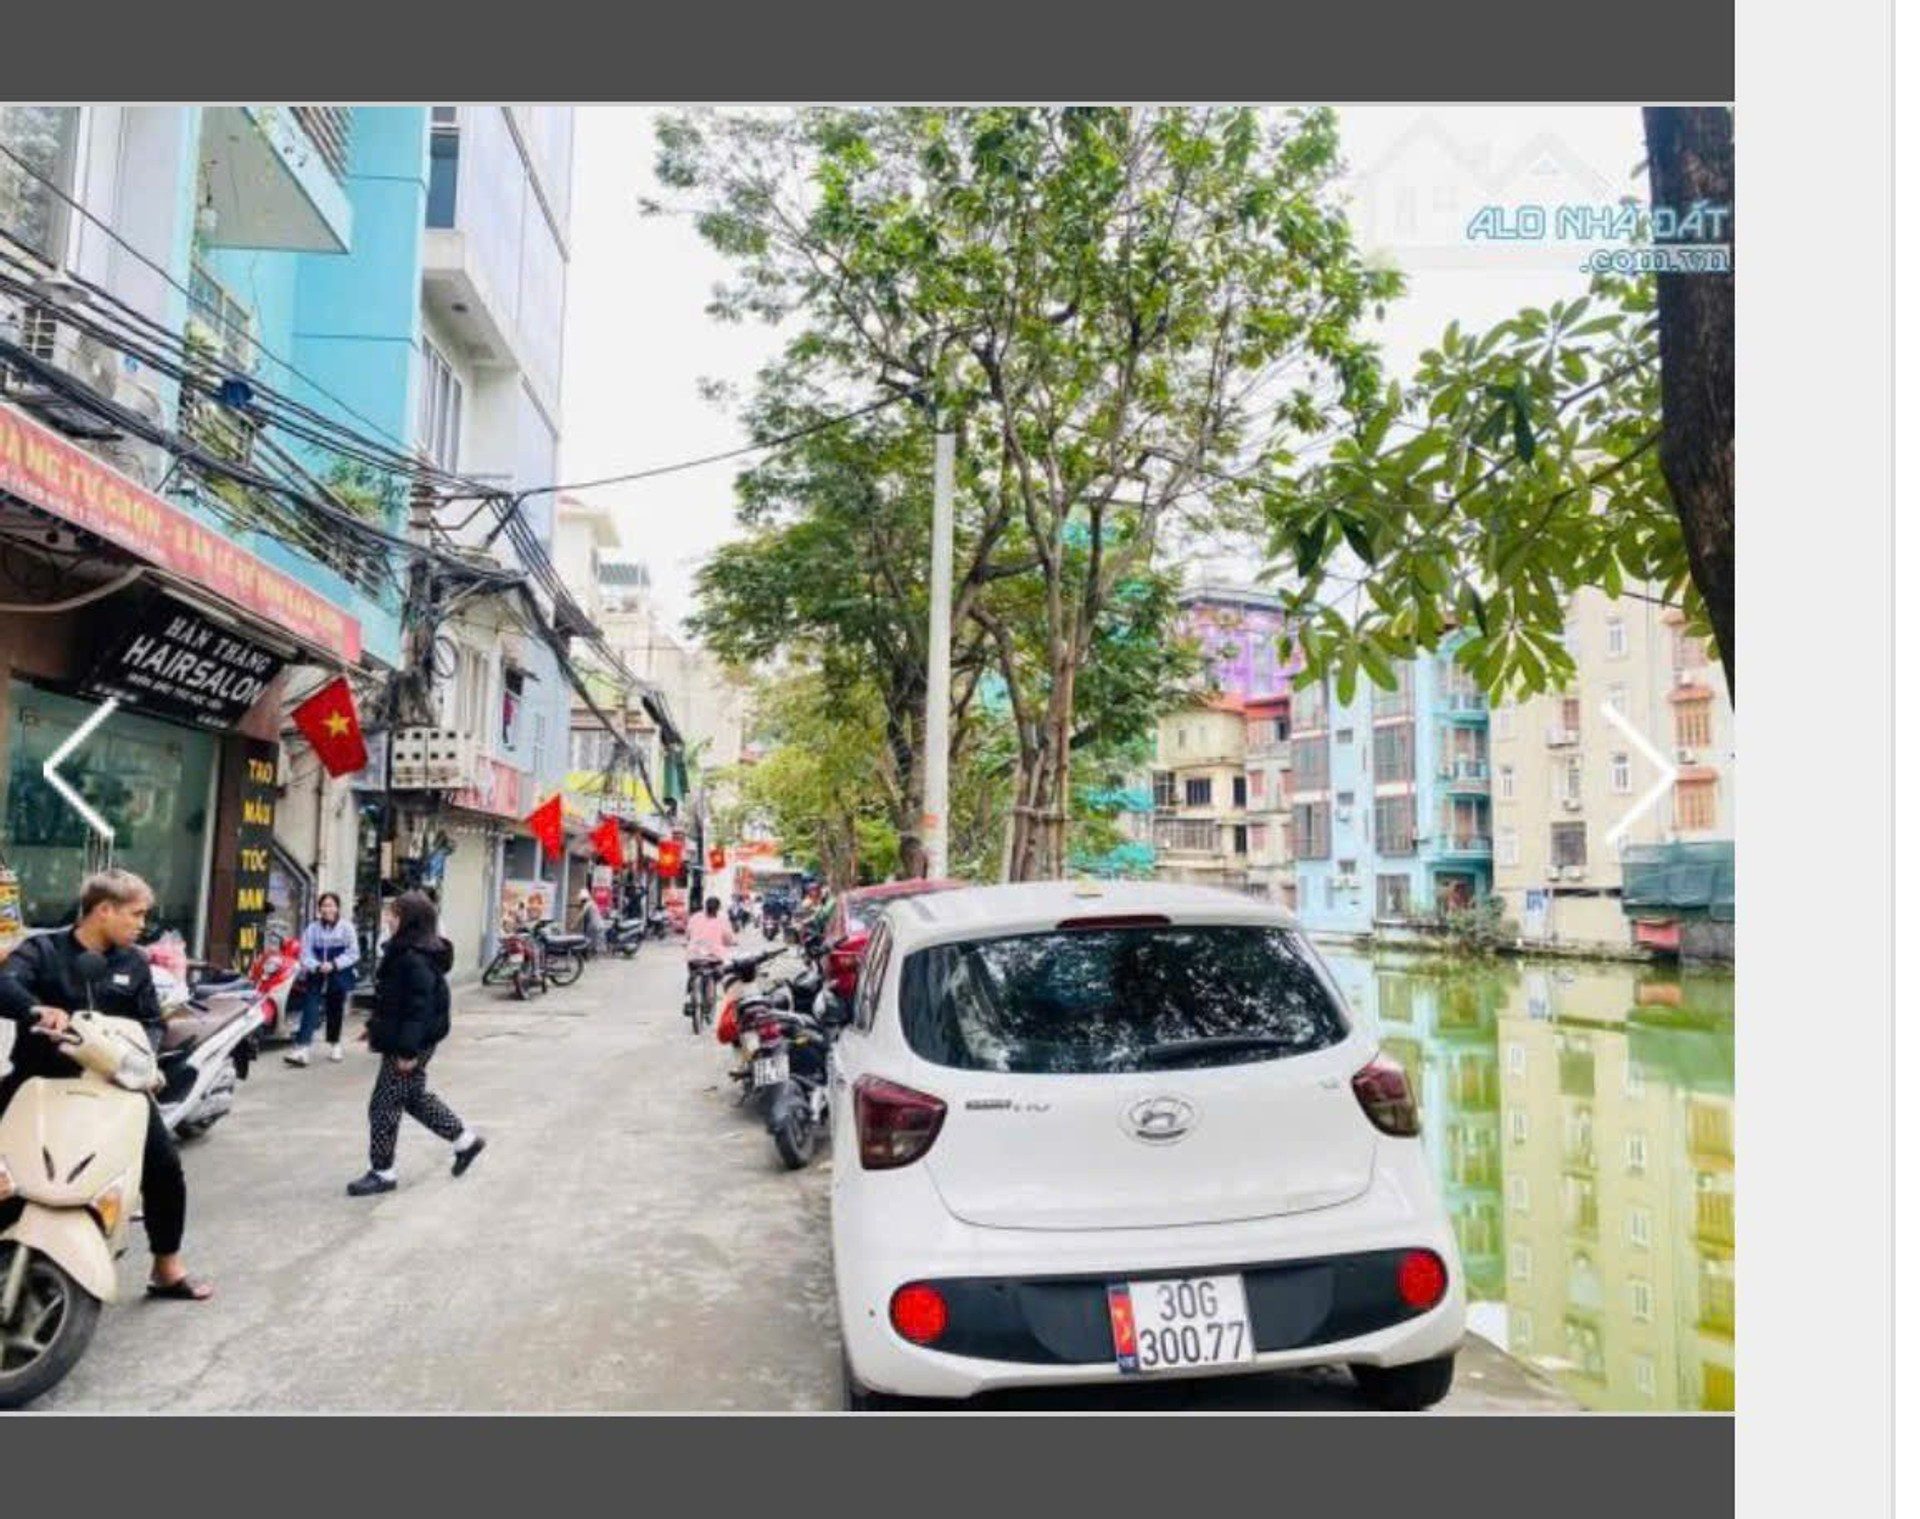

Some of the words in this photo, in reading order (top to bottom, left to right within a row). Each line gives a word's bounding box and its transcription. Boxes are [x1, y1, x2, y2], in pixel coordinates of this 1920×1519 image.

[121, 634, 264, 705] HAIRSALON
[1157, 1281, 1218, 1321] 30G
[1140, 1321, 1244, 1366] 300.77
